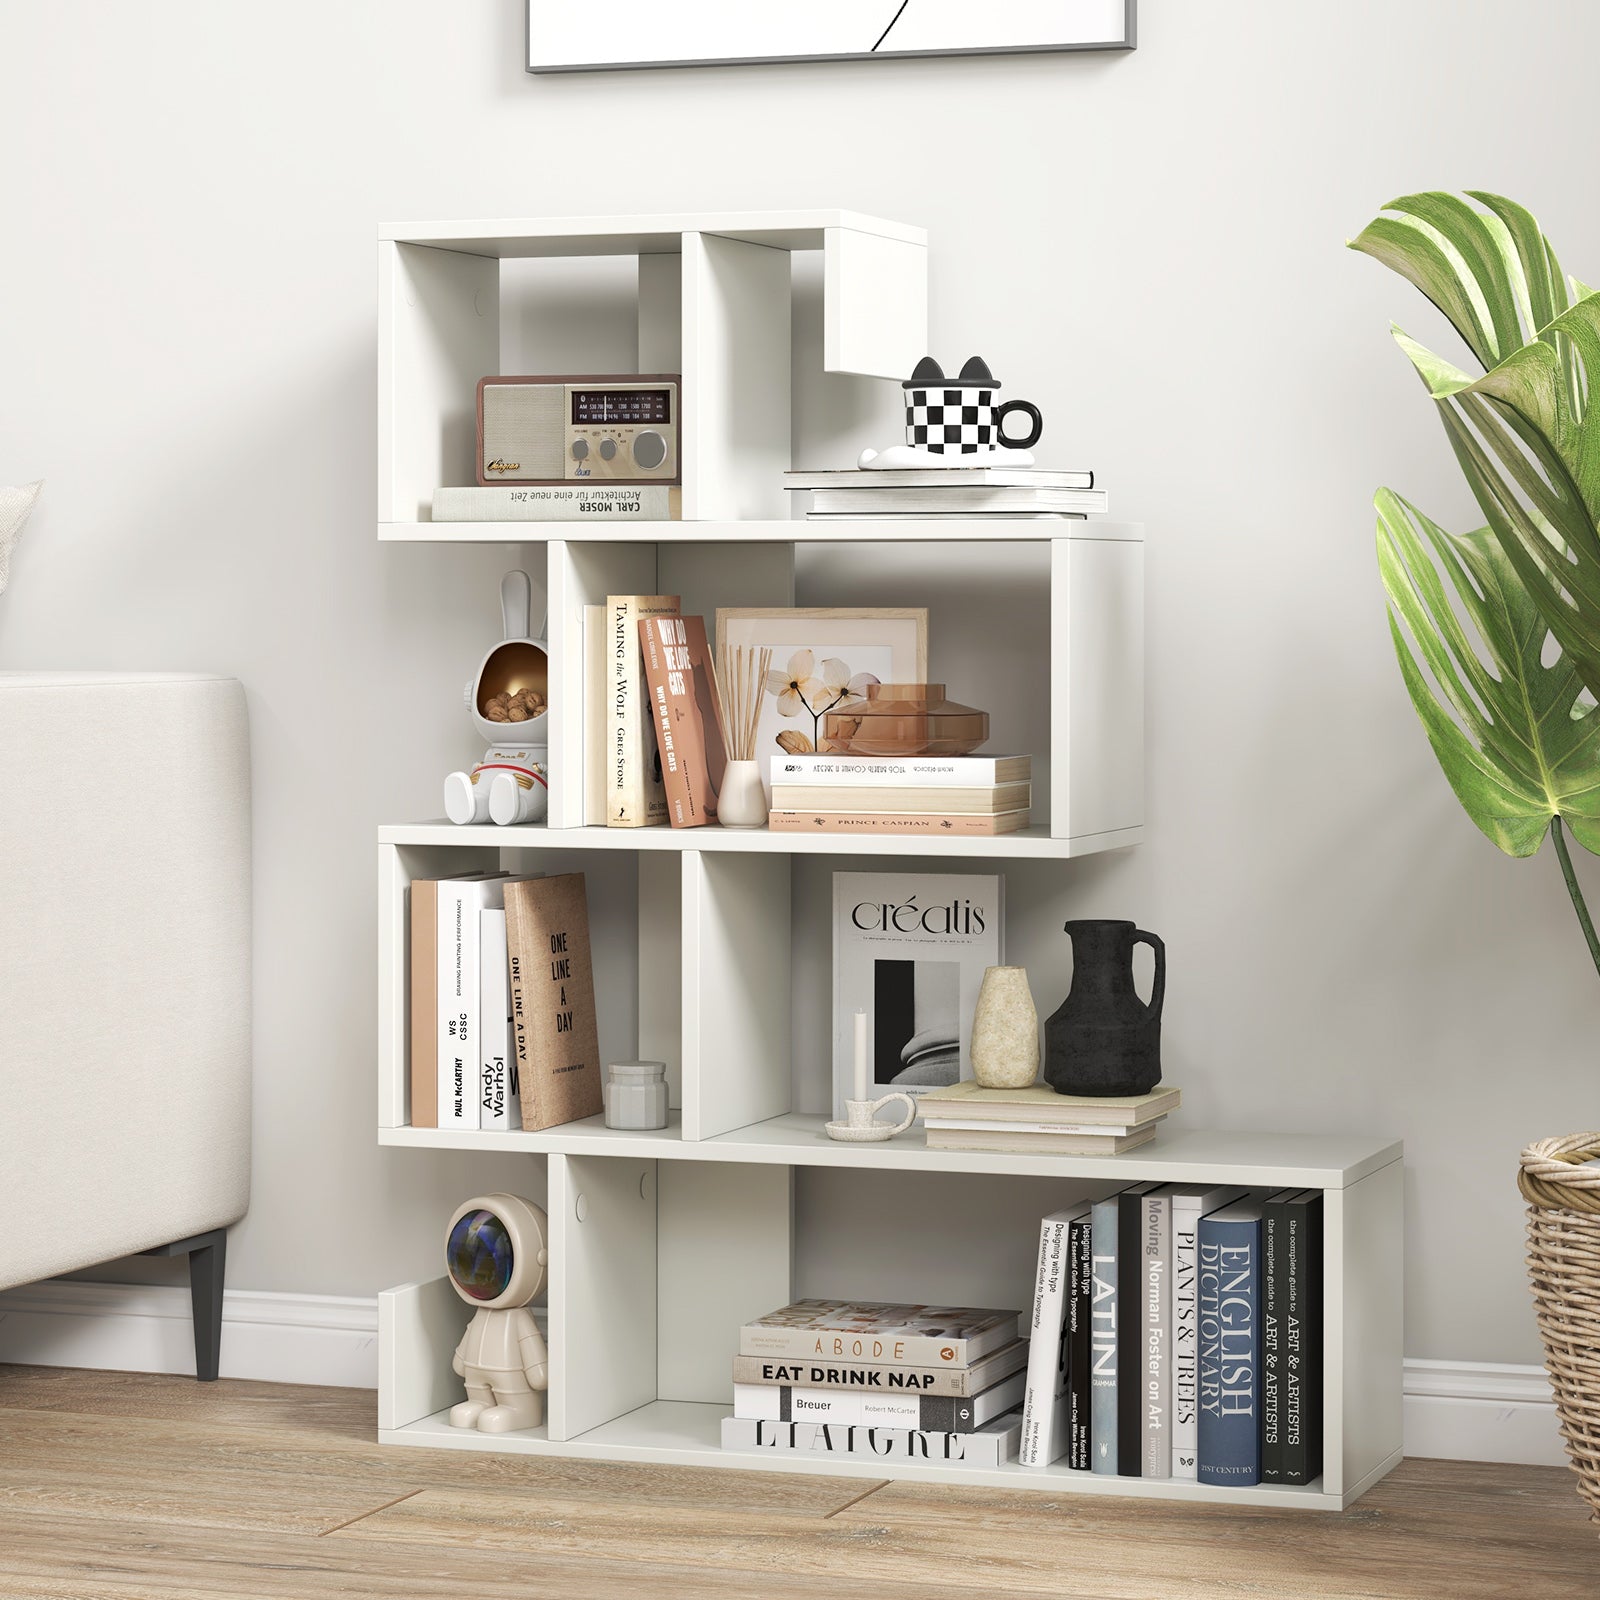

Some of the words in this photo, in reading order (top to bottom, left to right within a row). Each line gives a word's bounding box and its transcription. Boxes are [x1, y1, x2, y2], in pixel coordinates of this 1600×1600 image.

[511, 492, 528, 502] Zeit
[530, 492, 551, 500] neue
[554, 492, 573, 501] eine
[576, 491, 588, 501] für
[591, 491, 641, 501] Architektur
[580, 502, 612, 512] MOSER
[616, 502, 640, 512] CARL
[616, 604, 627, 659] TAMING
[657, 619, 676, 645] WHY
[675, 619, 687, 643] DO
[663, 646, 677, 670] WE
[676, 646, 692, 670] LOVE
[617, 662, 625, 676] the
[616, 679, 627, 719] WOLF
[656, 685, 666, 703] WHY
[660, 705, 667, 716] DO
[662, 717, 670, 730] WE
[617, 728, 625, 756] GREG
[663, 731, 674, 751] LOVE
[666, 753, 677, 772] CATS
[617, 758, 625, 790] STONE
[851, 895, 985, 934] créatis
[551, 933, 568, 954] ONE
[511, 957, 521, 983] ONE
[552, 959, 570, 981] LINE
[514, 989, 523, 1017] LINE
[560, 987, 567, 1006] A
[449, 1020, 456, 1036] WS
[517, 1023, 524, 1031] A
[557, 1012, 573, 1033] DAY
[518, 1037, 527, 1060] DAY
[454, 1058, 463, 1097] McCARTHY
[482, 1063, 497, 1109] Andy
[493, 1056, 504, 1118] Warhol
[455, 1098, 463, 1117] PAUL
[1146, 1200, 1162, 1256] Moving
[1051, 1223, 1064, 1259] Designing
[1081, 1224, 1091, 1261] Designing
[1051, 1260, 1060, 1276] with
[1083, 1262, 1091, 1277] with
[1178, 1232, 1194, 1320] PLANTS
[1048, 1277, 1058, 1293] type
[1081, 1278, 1091, 1295] type
[1149, 1261, 1163, 1323] Norman
[1034, 1294, 1044, 1329] Typography
[1092, 1256, 1116, 1375] LATIN
[1268, 1302, 1274, 1310] to
[1290, 1302, 1296, 1312] to
[1178, 1326, 1194, 1342] &
[1201, 1244, 1220, 1418] DICTIONARY
[1220, 1244, 1252, 1418] ENGLISH
[1266, 1314, 1278, 1350] ART
[1288, 1315, 1299, 1351] ART
[814, 1338, 904, 1359] ABODE
[1149, 1329, 1163, 1377] Foster
[1266, 1354, 1278, 1368] &
[1288, 1355, 1300, 1370] &
[762, 1365, 803, 1381] EAT
[811, 1368, 882, 1386] DRINK
[888, 1373, 935, 1389] NAP
[1178, 1350, 1194, 1424] TREES
[1149, 1381, 1159, 1400] on
[796, 1399, 831, 1411] Breuer
[864, 1404, 886, 1413] Robert
[887, 1407, 916, 1415] McCarter
[1149, 1405, 1162, 1429] Art
[1266, 1371, 1278, 1443] ARTISTS
[1288, 1372, 1299, 1445] ARTISTS
